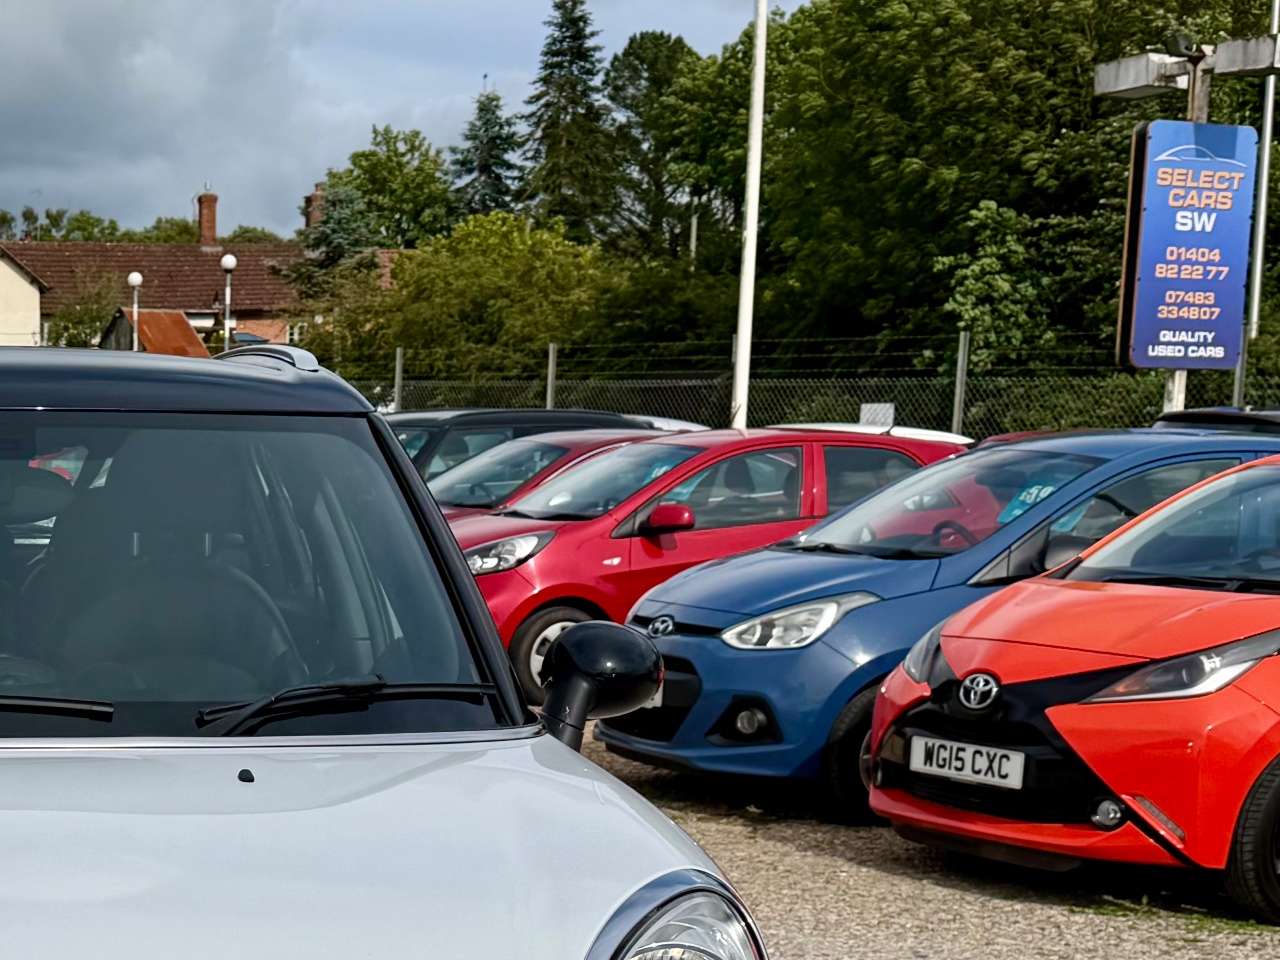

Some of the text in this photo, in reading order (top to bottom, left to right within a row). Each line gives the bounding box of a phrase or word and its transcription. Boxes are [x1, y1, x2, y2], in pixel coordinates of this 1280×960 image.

[1156, 168, 1245, 190] SELECT
[1168, 188, 1233, 210] CARS
[1175, 211, 1216, 232] SW
[1166, 247, 1221, 263] 01404
[1165, 291, 1215, 304] 07483
[1157, 306, 1221, 320] 334807
[1159, 330, 1215, 342] QUALITY
[1148, 345, 1224, 358] USED CARS
[924, 741, 1010, 779] WG15 CXC
